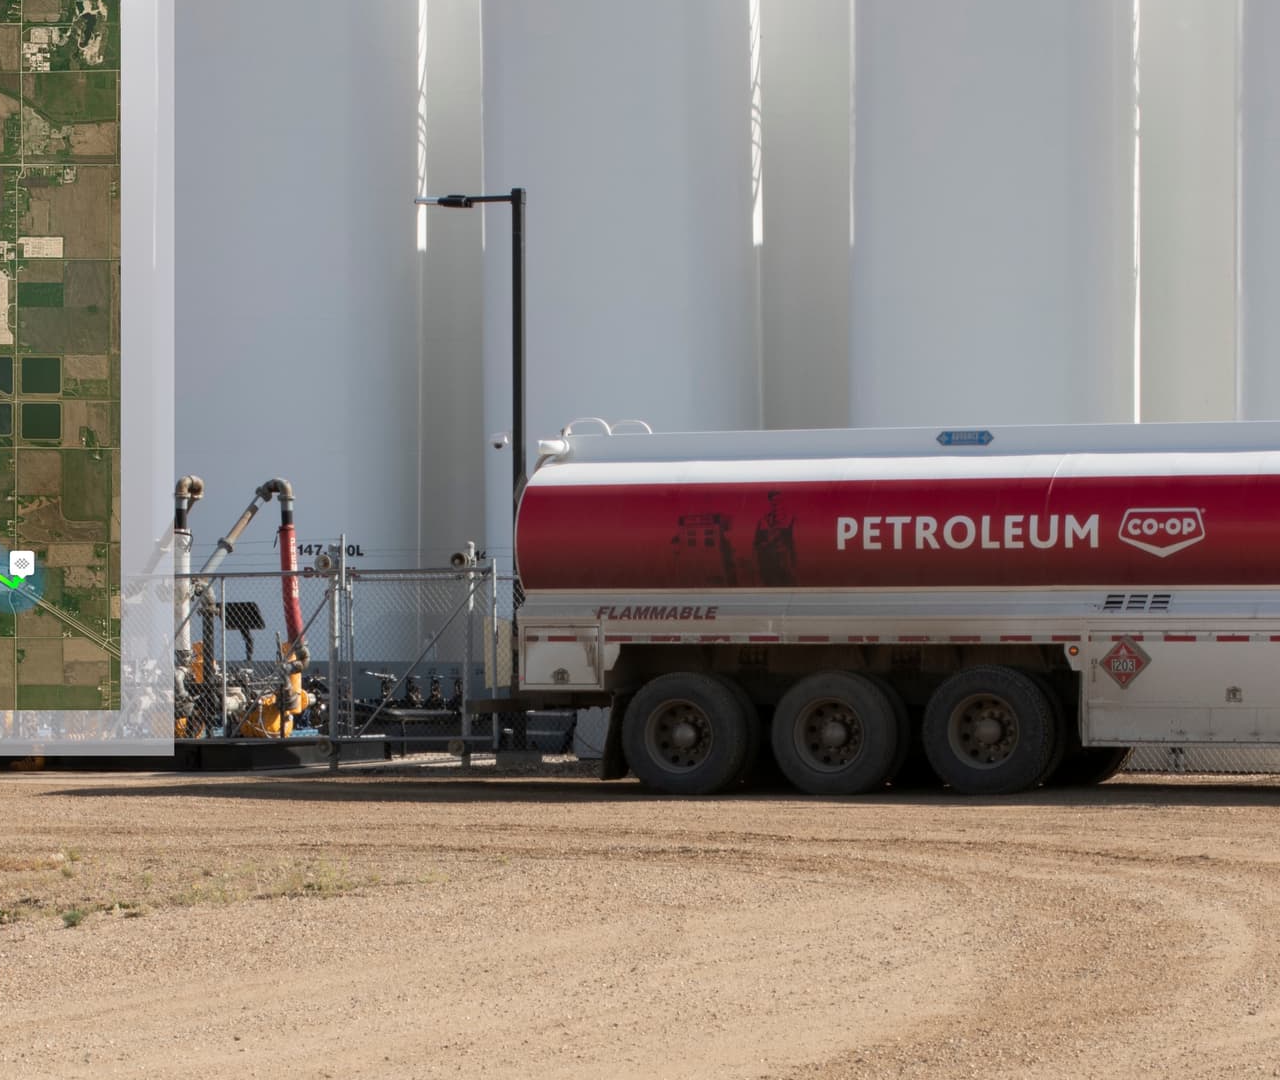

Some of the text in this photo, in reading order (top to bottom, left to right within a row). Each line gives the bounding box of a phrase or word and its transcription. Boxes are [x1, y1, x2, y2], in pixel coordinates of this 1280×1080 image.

[836, 514, 1197, 550] PETROLEUM CO-OP
[596, 606, 718, 620] FLAMMABLE
[1113, 660, 1135, 672] 1203
